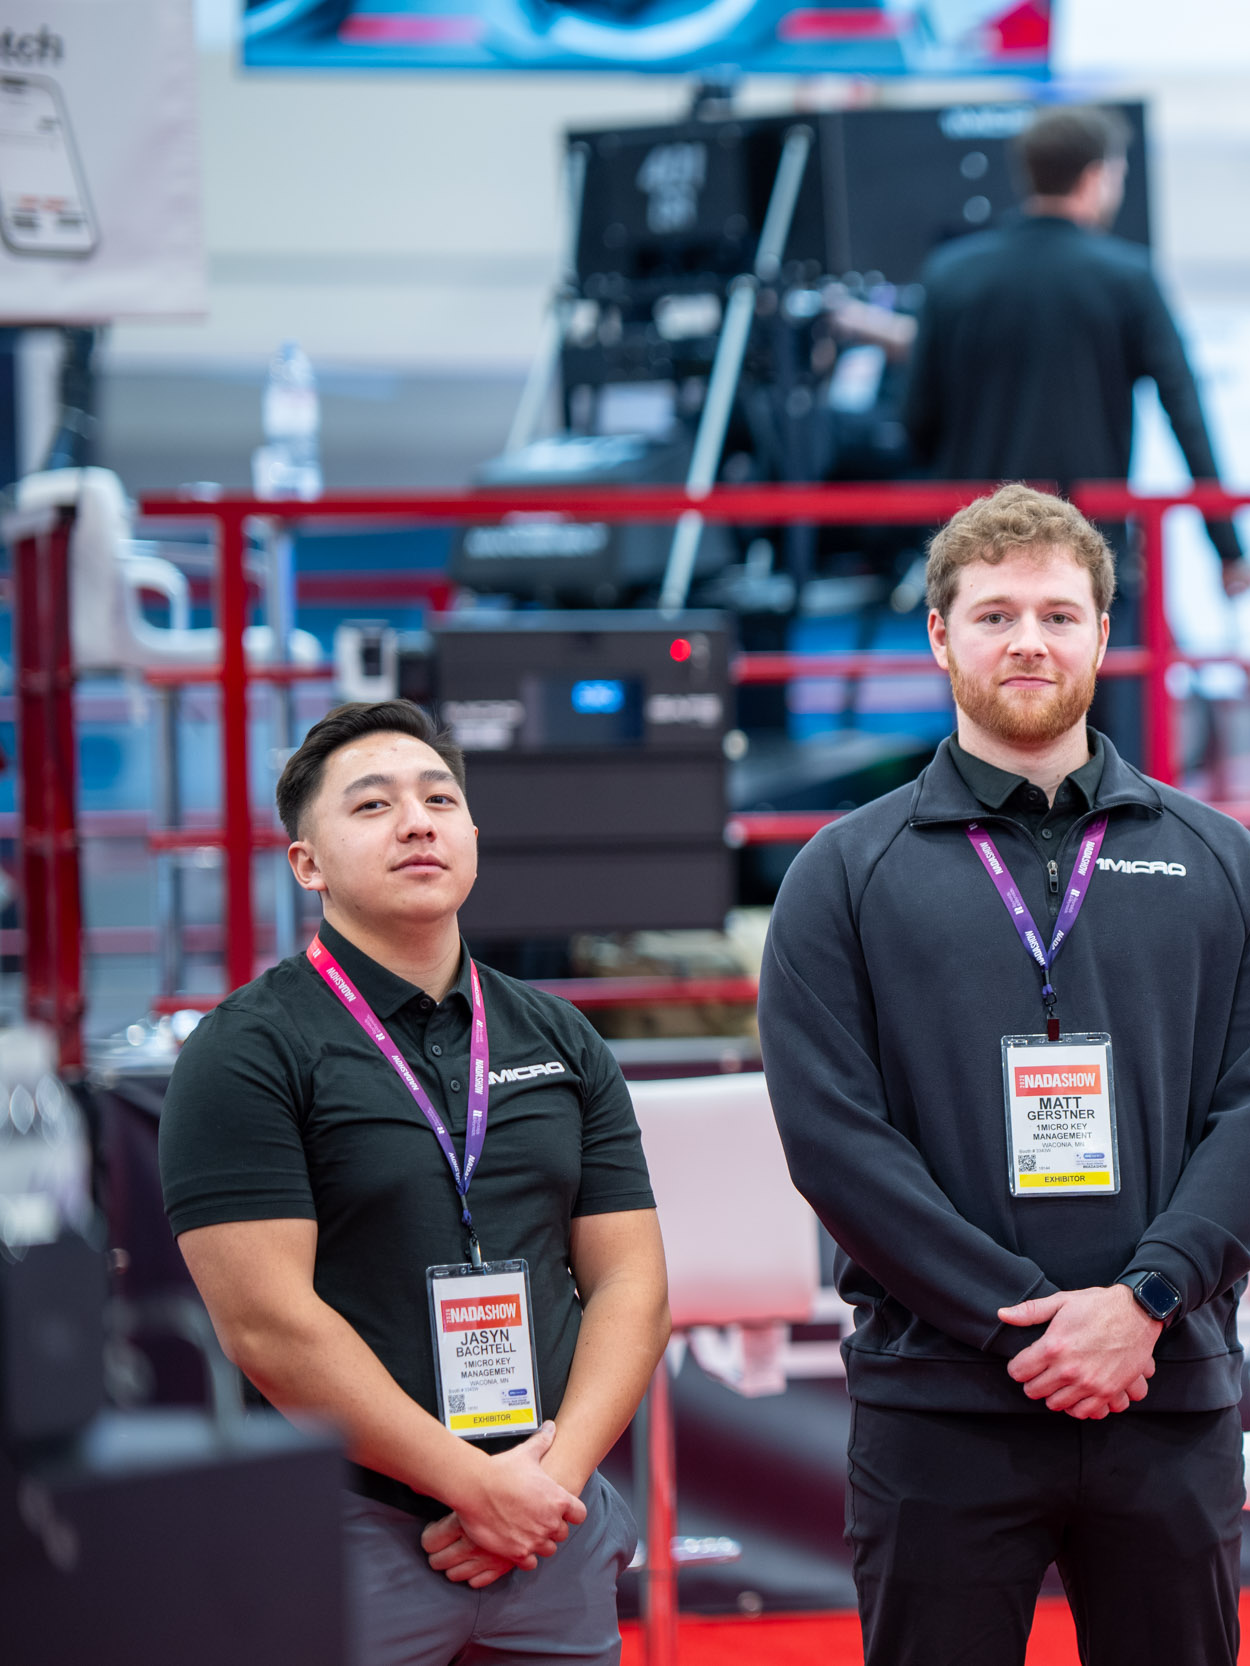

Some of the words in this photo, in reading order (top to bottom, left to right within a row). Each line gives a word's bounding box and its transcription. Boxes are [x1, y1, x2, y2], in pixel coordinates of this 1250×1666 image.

[979, 841, 1003, 875] NADASHOW
[1077, 841, 1095, 876] NADASHOW
[1096, 858, 1186, 877] 1MICRO
[326, 966, 357, 1003] NADASHOW
[392, 1055, 419, 1091] NADASHOW
[474, 1058, 484, 1095] NADASHOW
[488, 1062, 566, 1085] MICRO
[1024, 1072, 1096, 1088] NADASHOW
[1039, 1096, 1082, 1110] MATT
[1027, 1109, 1095, 1120] GERSTNER
[1033, 1132, 1092, 1140] MANAGEMENT
[1044, 1175, 1085, 1183] EXHIBITOR
[450, 1303, 517, 1323] NADASHOW
[460, 1329, 510, 1346] JASYN
[456, 1343, 517, 1357] BACHTELL
[464, 1359, 494, 1369] 1MICRO
[495, 1357, 511, 1366] KEY
[461, 1367, 516, 1379] MANAGEMENT
[473, 1414, 511, 1424] EXHIBITOR
